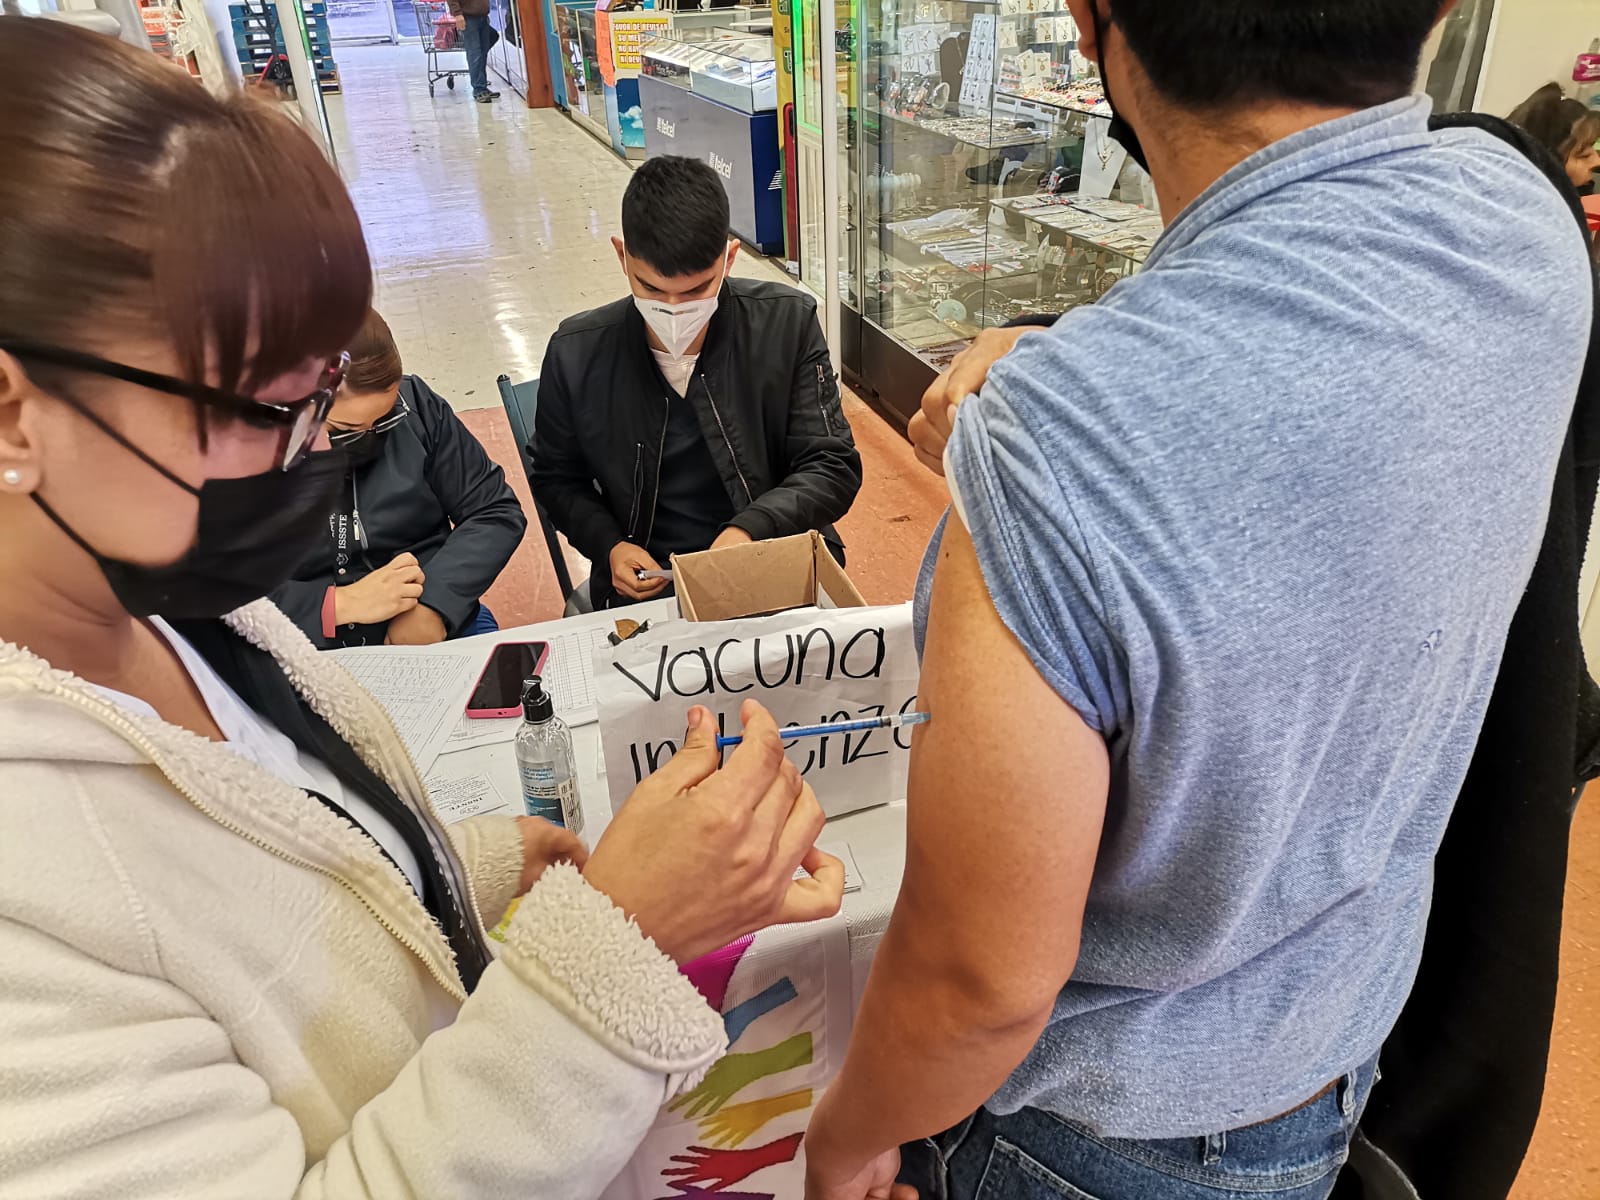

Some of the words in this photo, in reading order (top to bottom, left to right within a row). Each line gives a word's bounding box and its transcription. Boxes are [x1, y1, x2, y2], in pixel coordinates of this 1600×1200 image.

[633, 23, 641, 31] DE
[715, 154, 732, 179] telcel
[338, 514, 348, 549] ISSSTE
